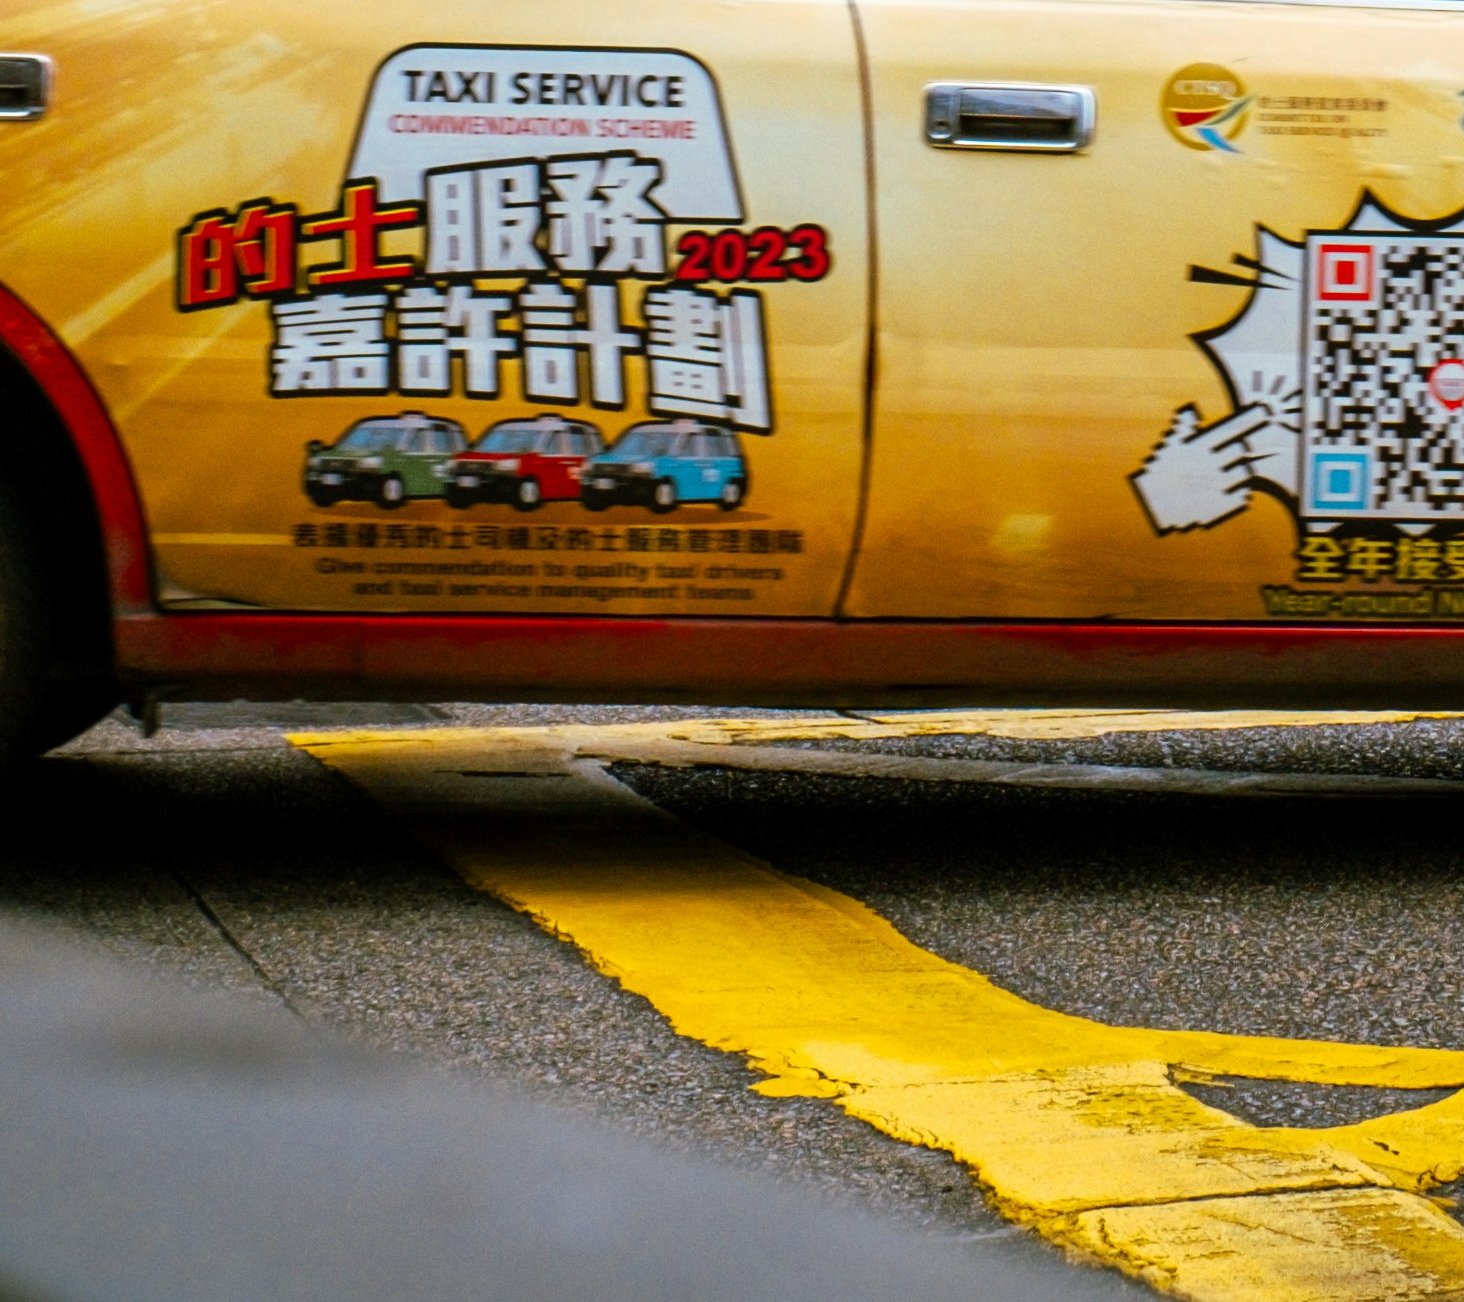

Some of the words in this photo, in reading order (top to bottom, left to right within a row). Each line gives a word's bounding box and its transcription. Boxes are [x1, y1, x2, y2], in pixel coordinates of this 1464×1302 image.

[388, 113, 591, 139] COMMENDATION
[597, 115, 698, 140] SCHEME
[402, 68, 495, 105] TAXI
[512, 70, 686, 108] SERVICE
[177, 150, 666, 311] 的士服務
[675, 224, 833, 284] 2023
[270, 276, 773, 436] 嘉許計劃
